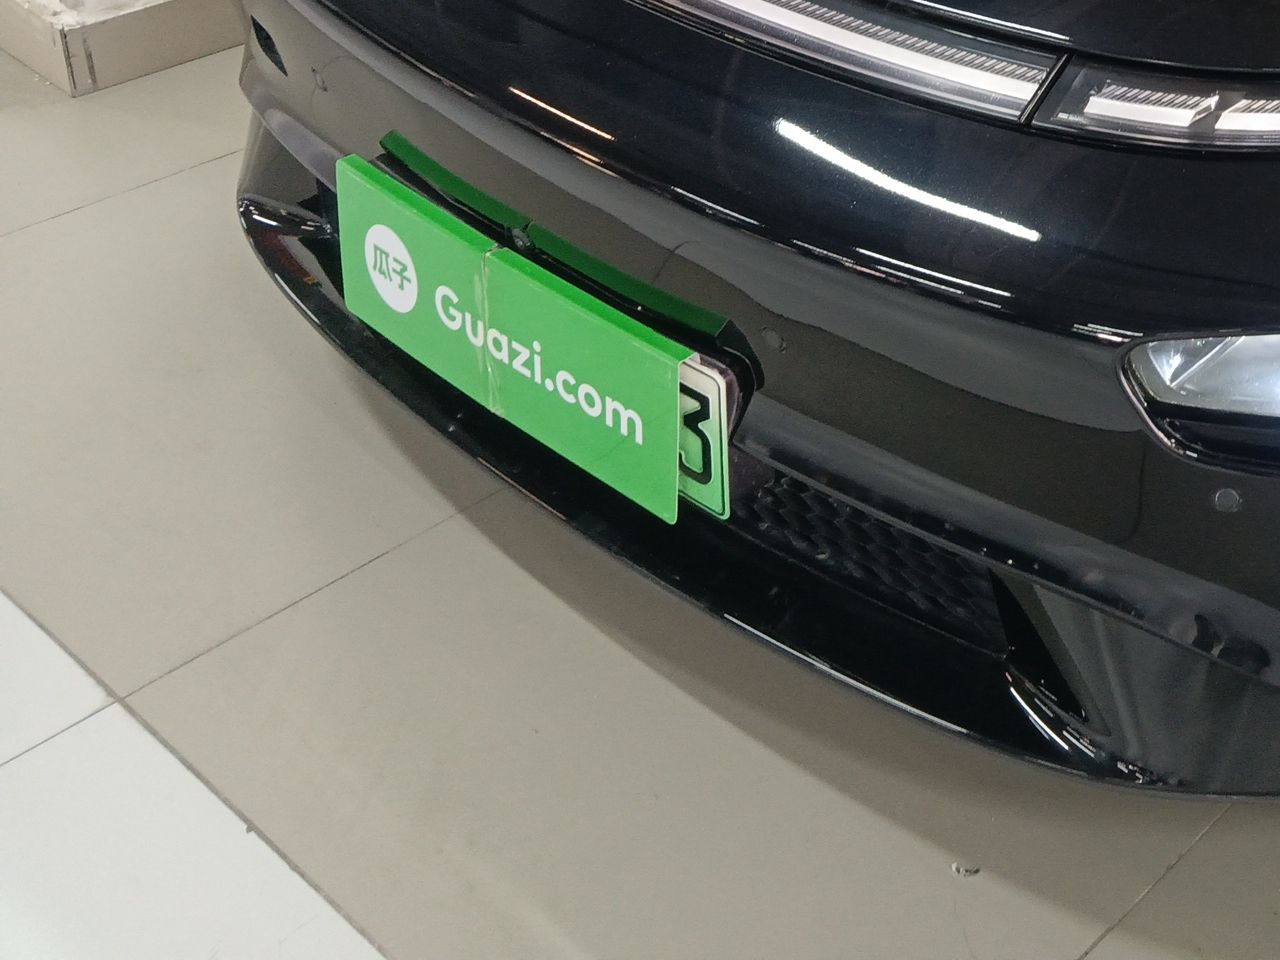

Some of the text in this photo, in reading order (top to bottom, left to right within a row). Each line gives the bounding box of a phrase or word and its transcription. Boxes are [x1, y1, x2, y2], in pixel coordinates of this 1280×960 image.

[373, 243, 412, 291] 瓜子
[434, 285, 644, 446] Guazi.com
[678, 380, 713, 486] 3
